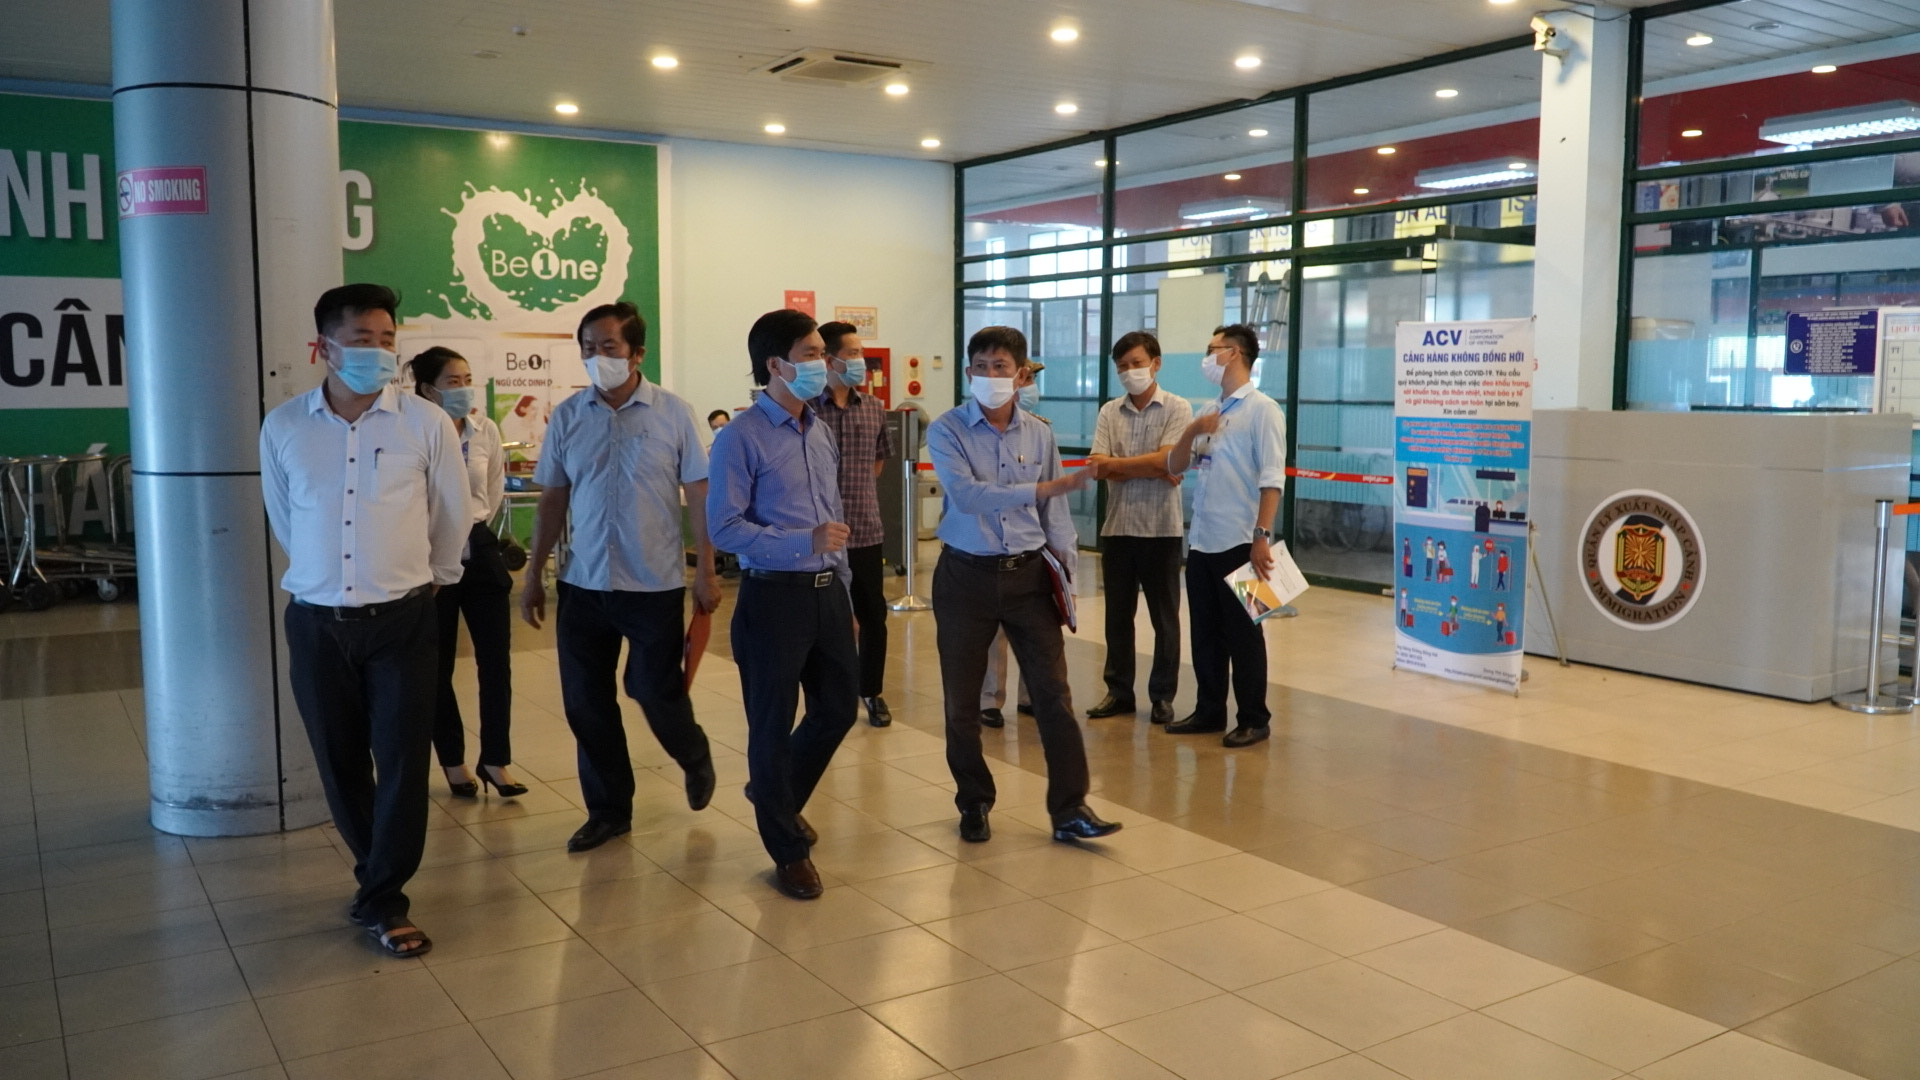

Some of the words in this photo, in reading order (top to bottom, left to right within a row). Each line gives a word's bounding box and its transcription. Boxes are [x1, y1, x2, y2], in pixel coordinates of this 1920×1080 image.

[134, 181, 146, 203] NO
[148, 178, 201, 202] SMOKING
[1422, 329, 1462, 346] ACV
[1451, 350, 1480, 362] KHÔNG
[1592, 581, 1687, 621] IMMIGRATION
